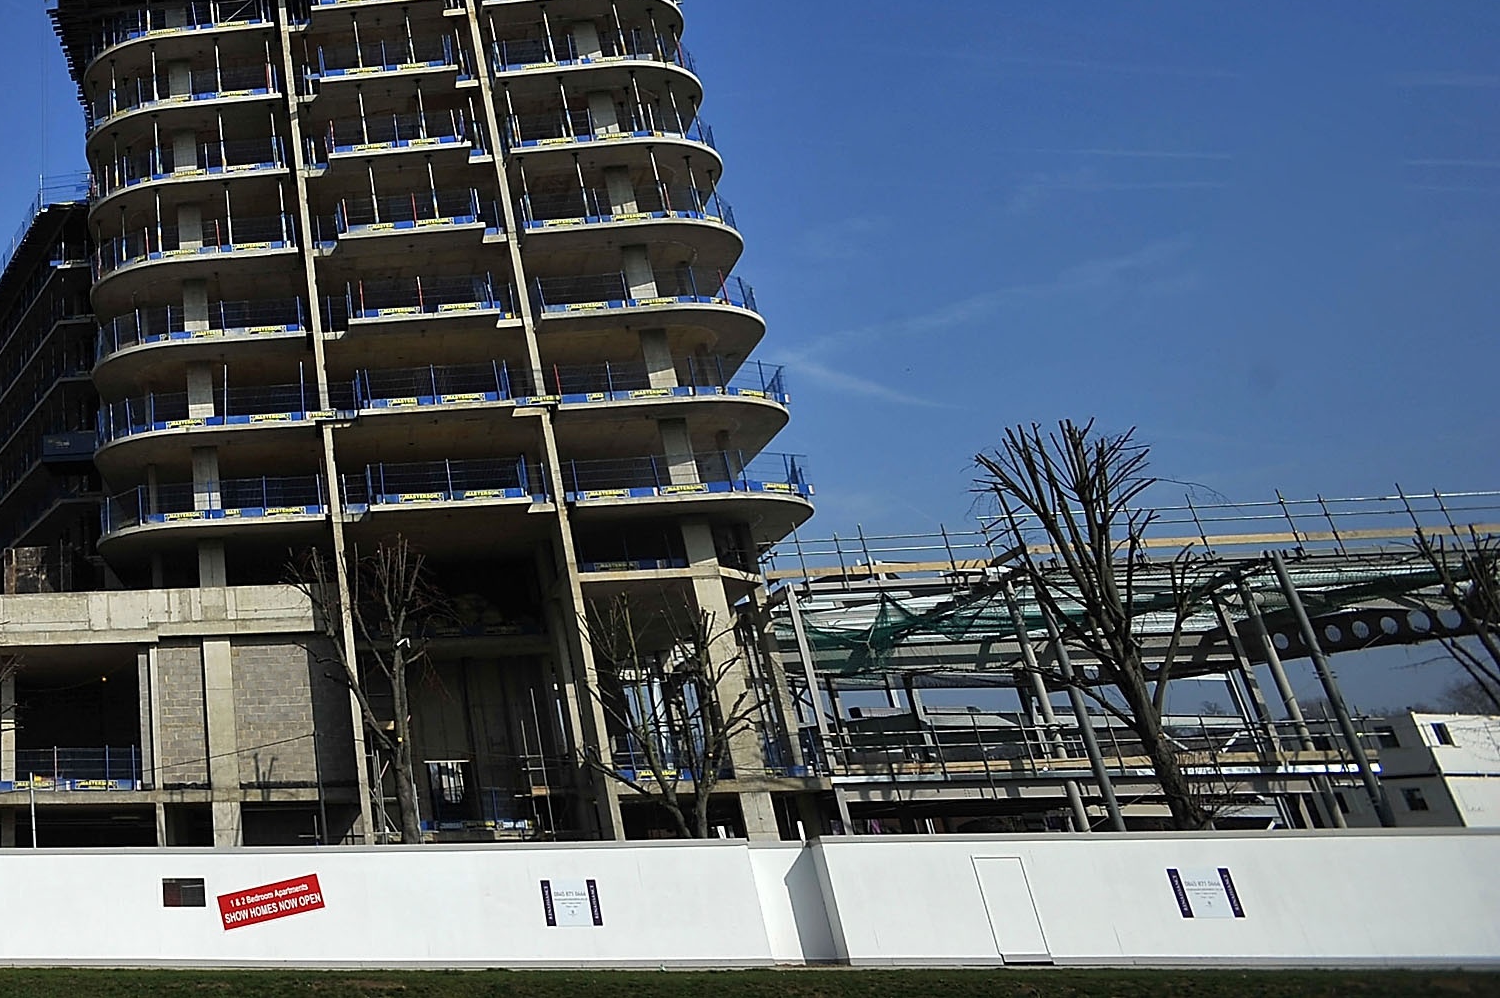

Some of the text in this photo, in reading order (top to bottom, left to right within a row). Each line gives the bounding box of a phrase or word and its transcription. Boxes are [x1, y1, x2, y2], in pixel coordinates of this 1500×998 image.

[246, 892, 274, 904] Bedroom
[274, 883, 309, 898] Apartments
[224, 892, 322, 924] SHOW HOMES NOW OPEN
